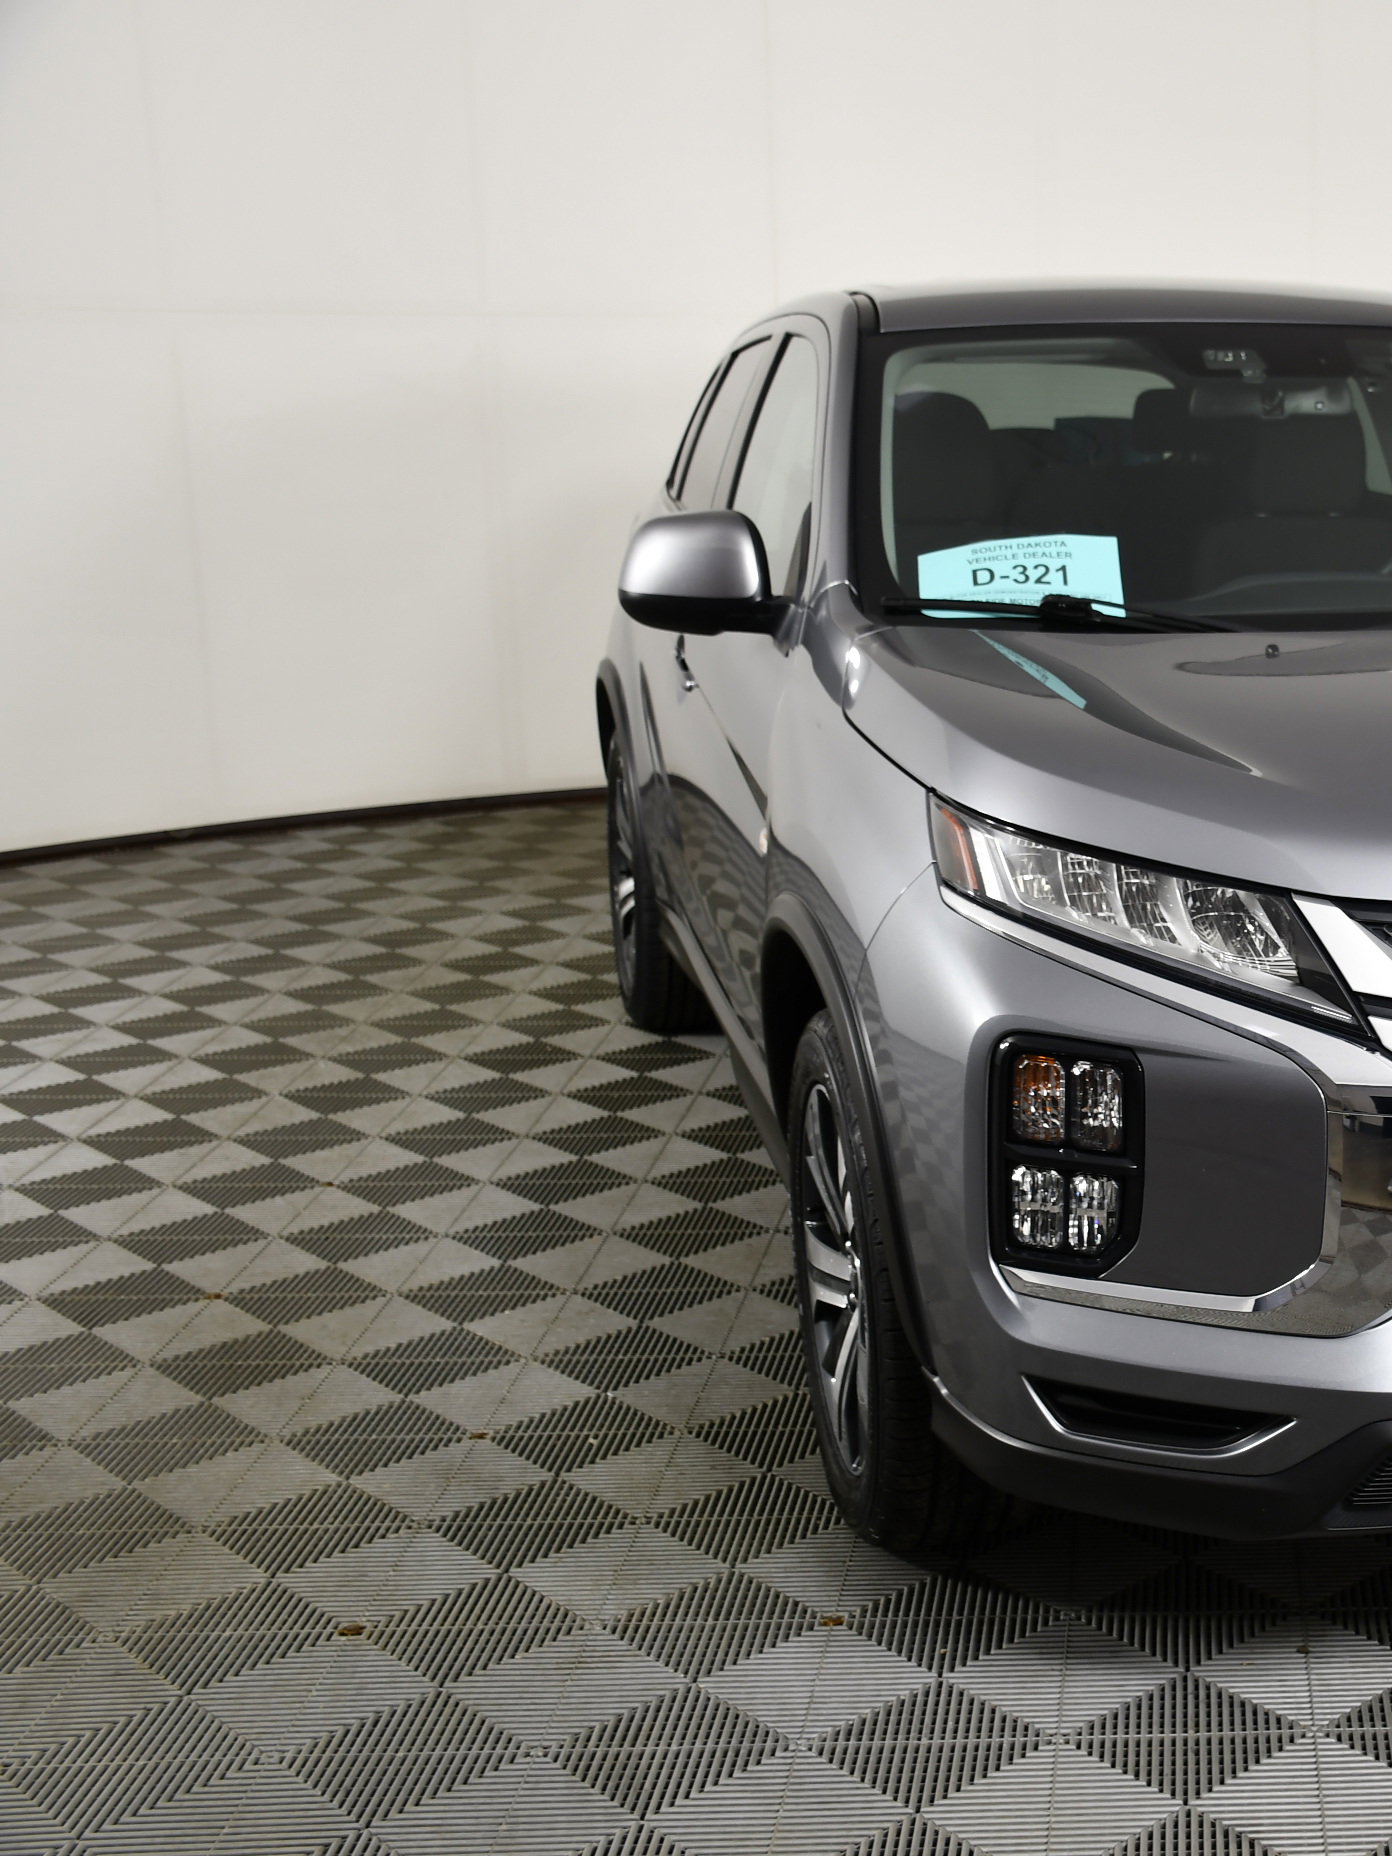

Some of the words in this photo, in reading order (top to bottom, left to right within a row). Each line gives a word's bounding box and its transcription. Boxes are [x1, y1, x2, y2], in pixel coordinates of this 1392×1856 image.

[971, 544, 1012, 555] SOUTH
[1017, 540, 1067, 550] DAKOTA
[967, 553, 1019, 566] VEHICLE
[1023, 551, 1072, 560] DEALER
[972, 564, 1068, 587] D-321
